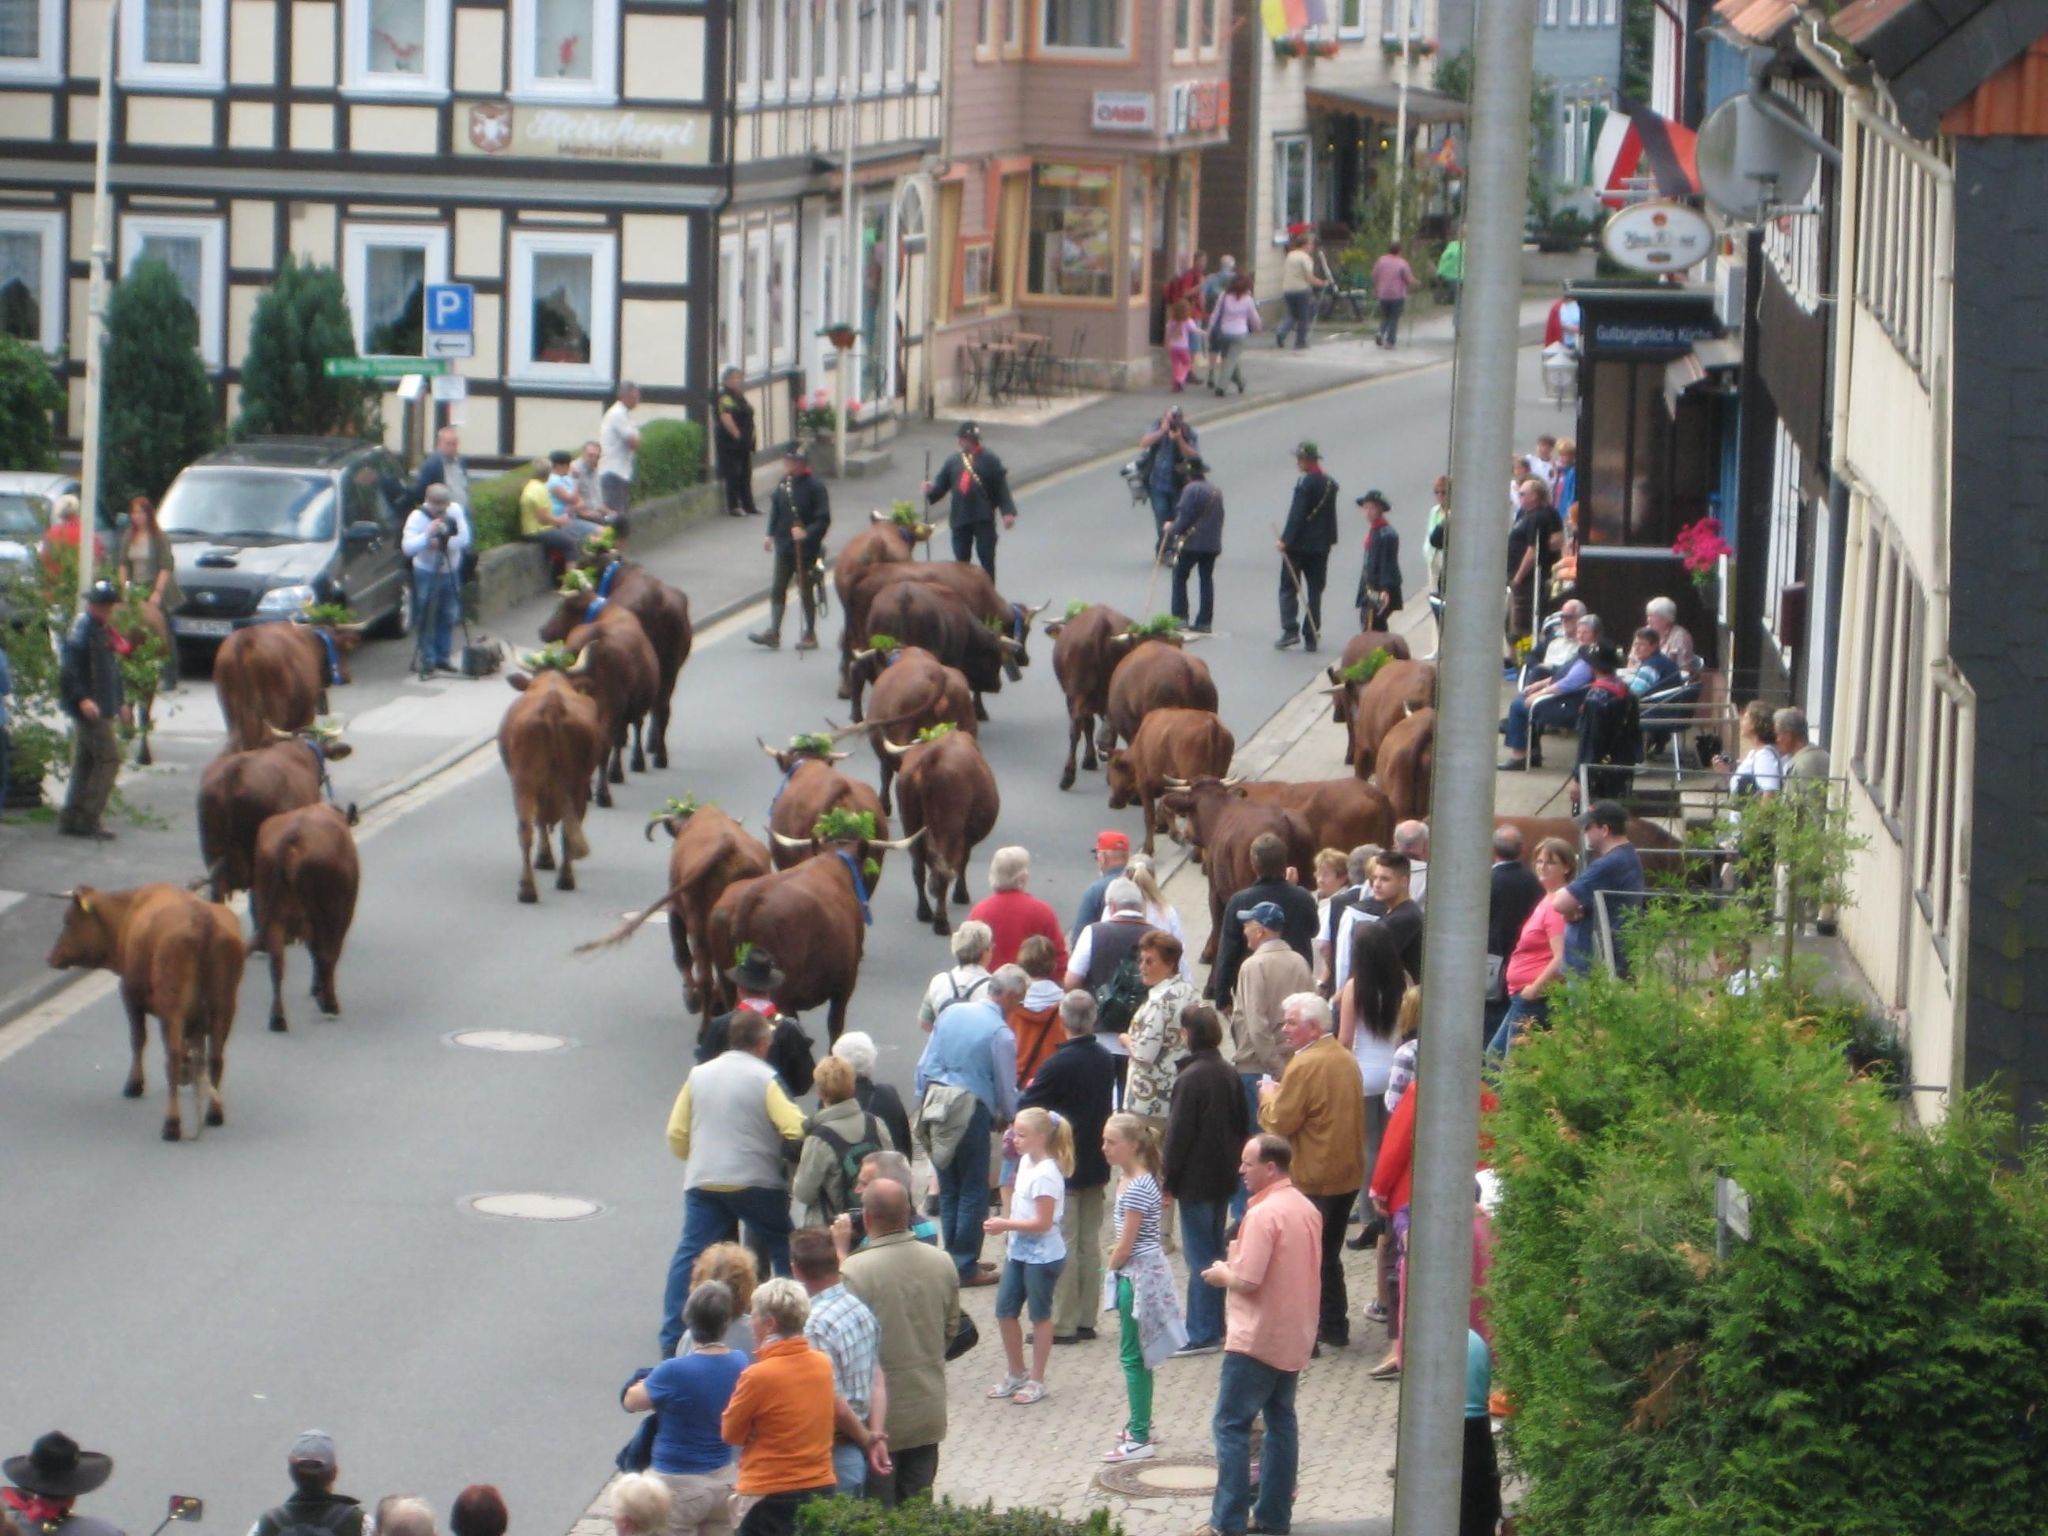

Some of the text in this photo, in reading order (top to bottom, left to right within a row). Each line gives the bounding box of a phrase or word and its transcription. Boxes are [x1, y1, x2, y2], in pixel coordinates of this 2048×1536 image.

[526, 109, 697, 145] Fleischerei
[436, 290, 460, 326] P
[1596, 324, 1674, 345] Gutbürgerliche
